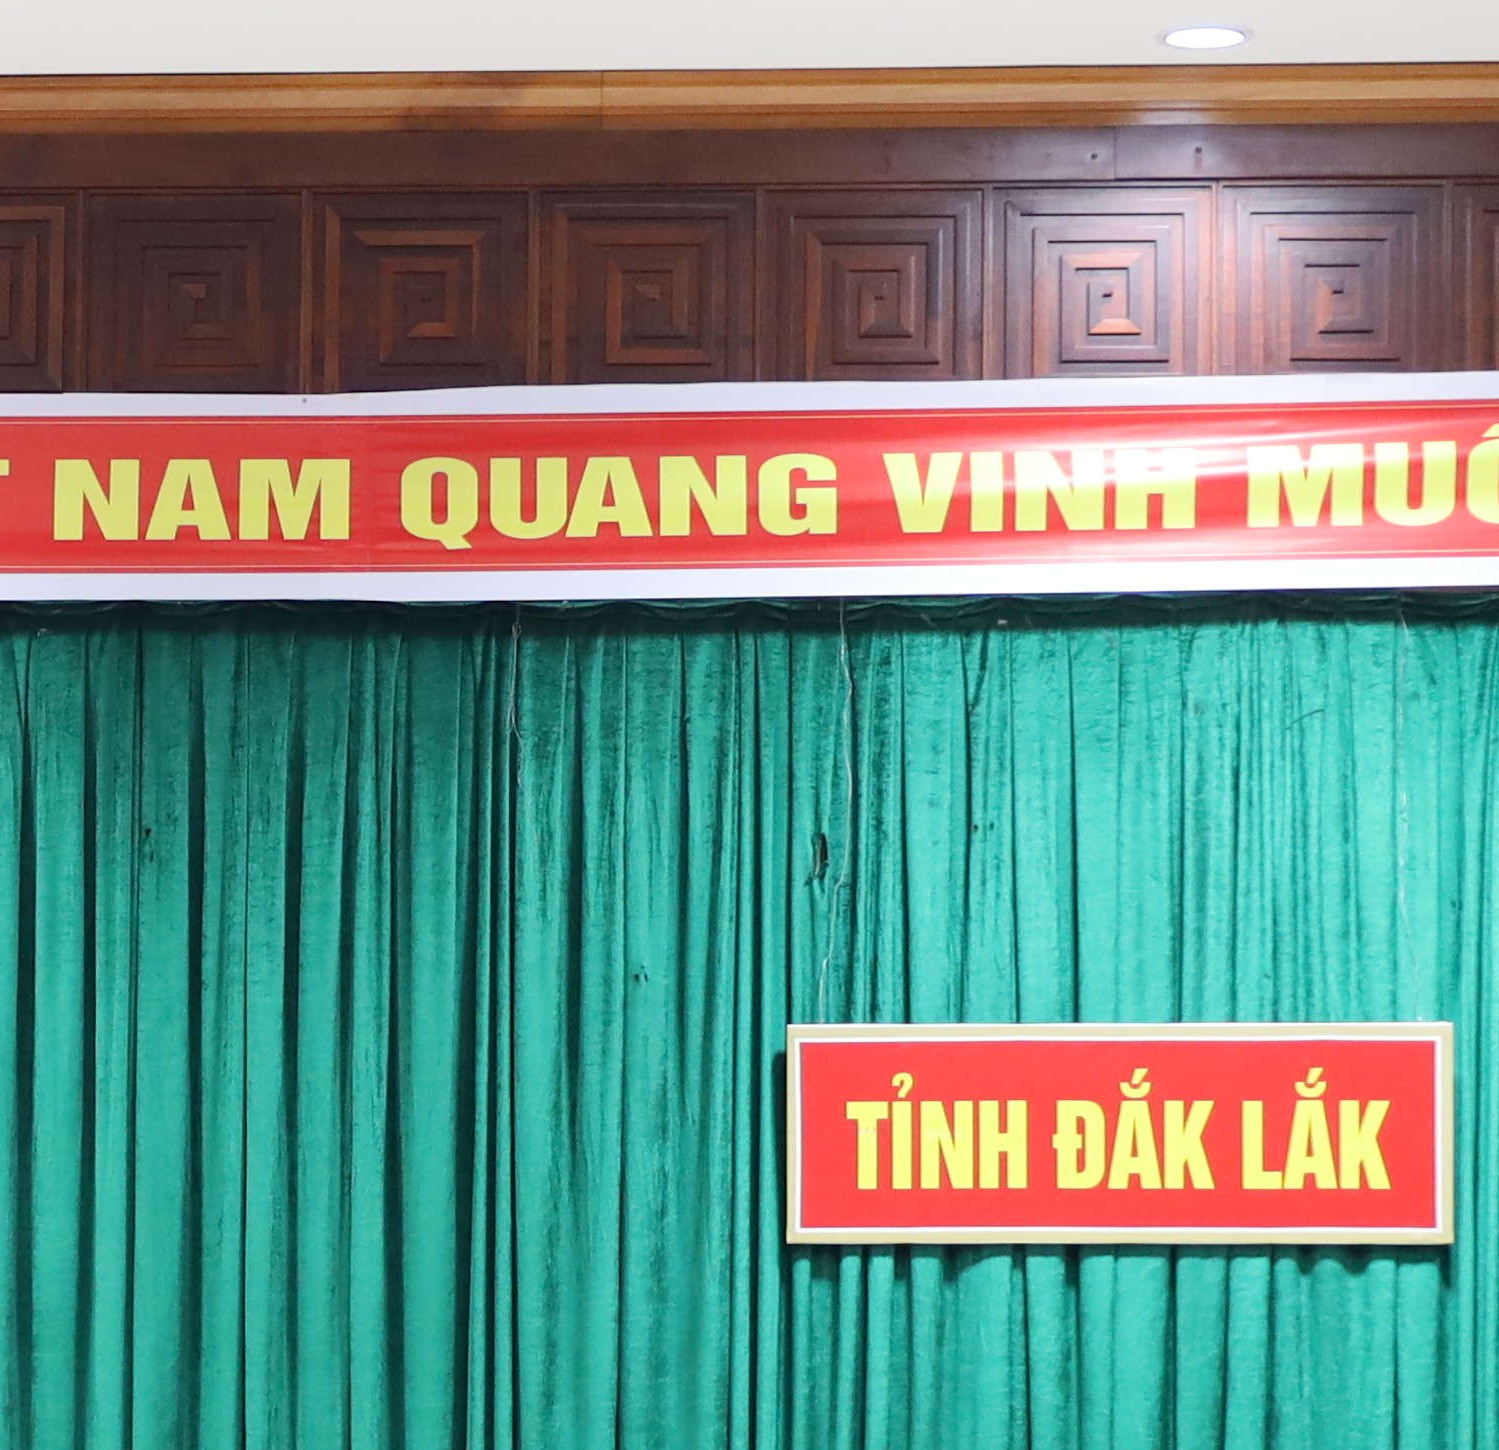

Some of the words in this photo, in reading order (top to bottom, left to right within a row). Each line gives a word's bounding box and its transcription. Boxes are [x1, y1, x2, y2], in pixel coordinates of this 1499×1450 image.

[52, 457, 353, 542] NAM
[398, 454, 839, 551] QUANG
[883, 447, 1198, 535] VINH
[846, 1072, 1029, 1190] TỈNH
[1051, 1067, 1216, 1190] ĐẮK
[1241, 1066, 1392, 1190] LẮK
